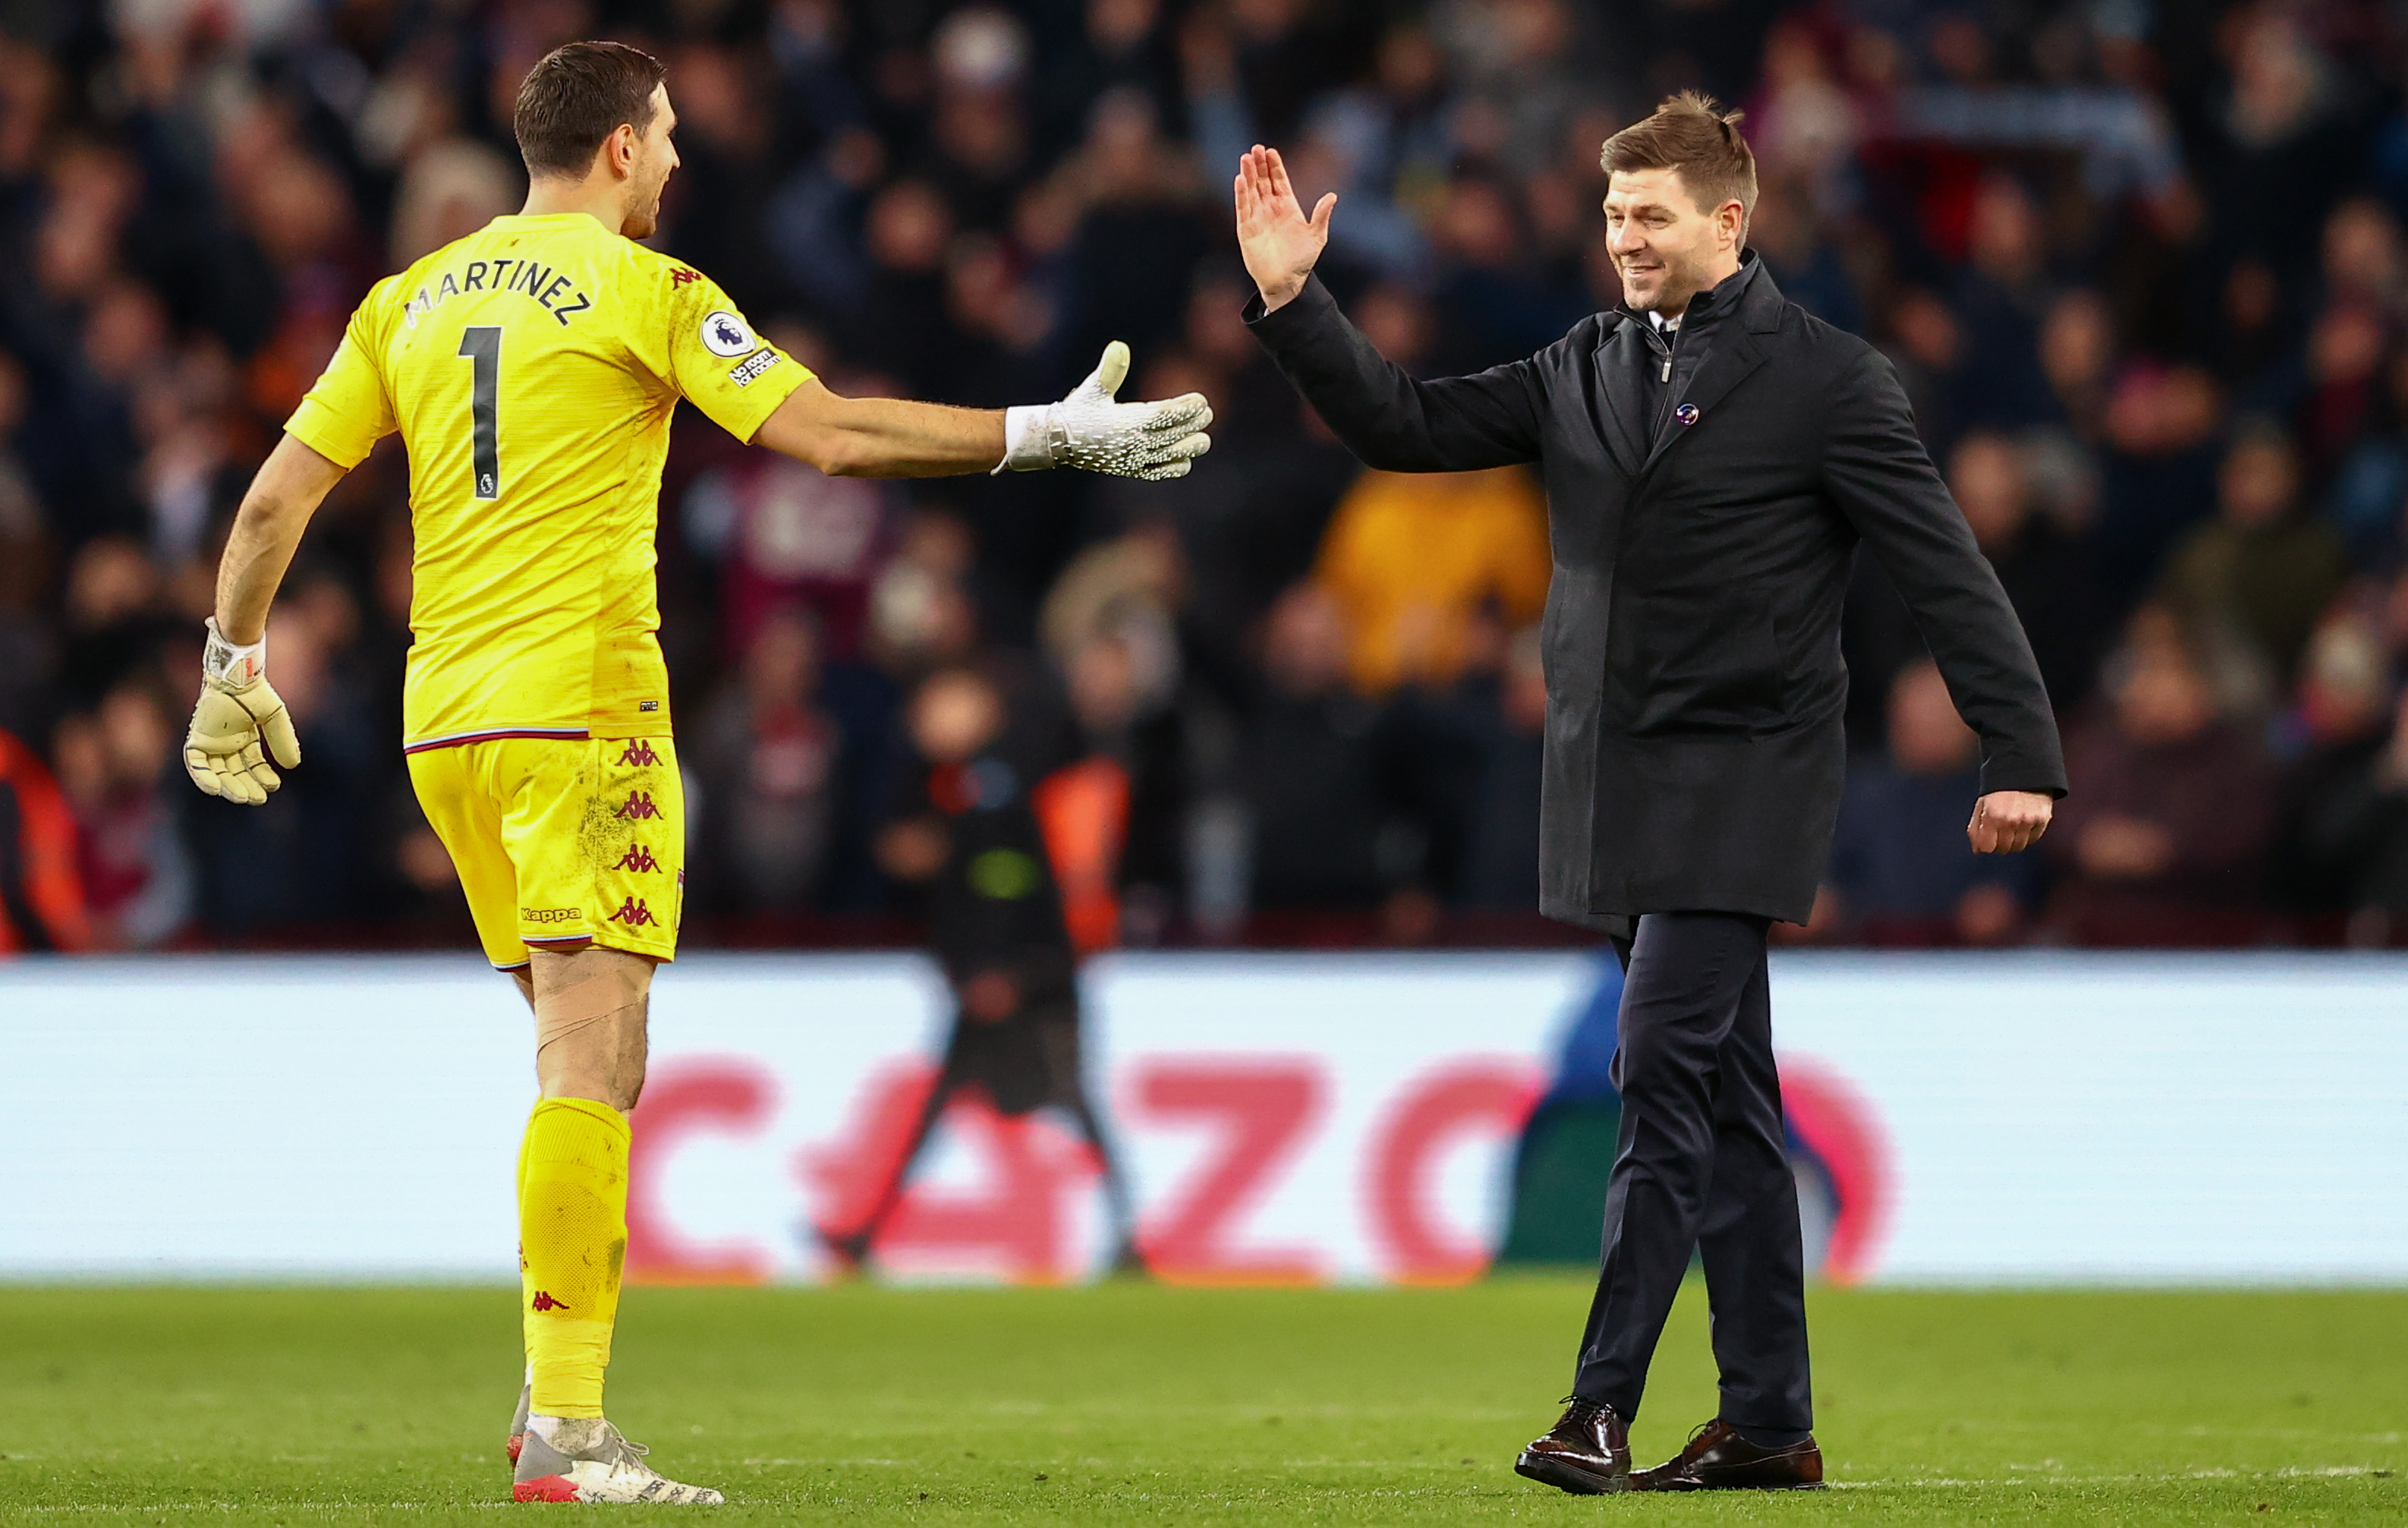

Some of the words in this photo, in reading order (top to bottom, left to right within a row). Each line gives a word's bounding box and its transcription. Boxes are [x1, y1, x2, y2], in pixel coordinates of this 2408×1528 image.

[403, 260, 591, 329] MARTINEZ
[729, 366, 748, 380] No
[744, 350, 772, 370] room
[458, 326, 503, 499] 1
[521, 908, 582, 923] Kappa
